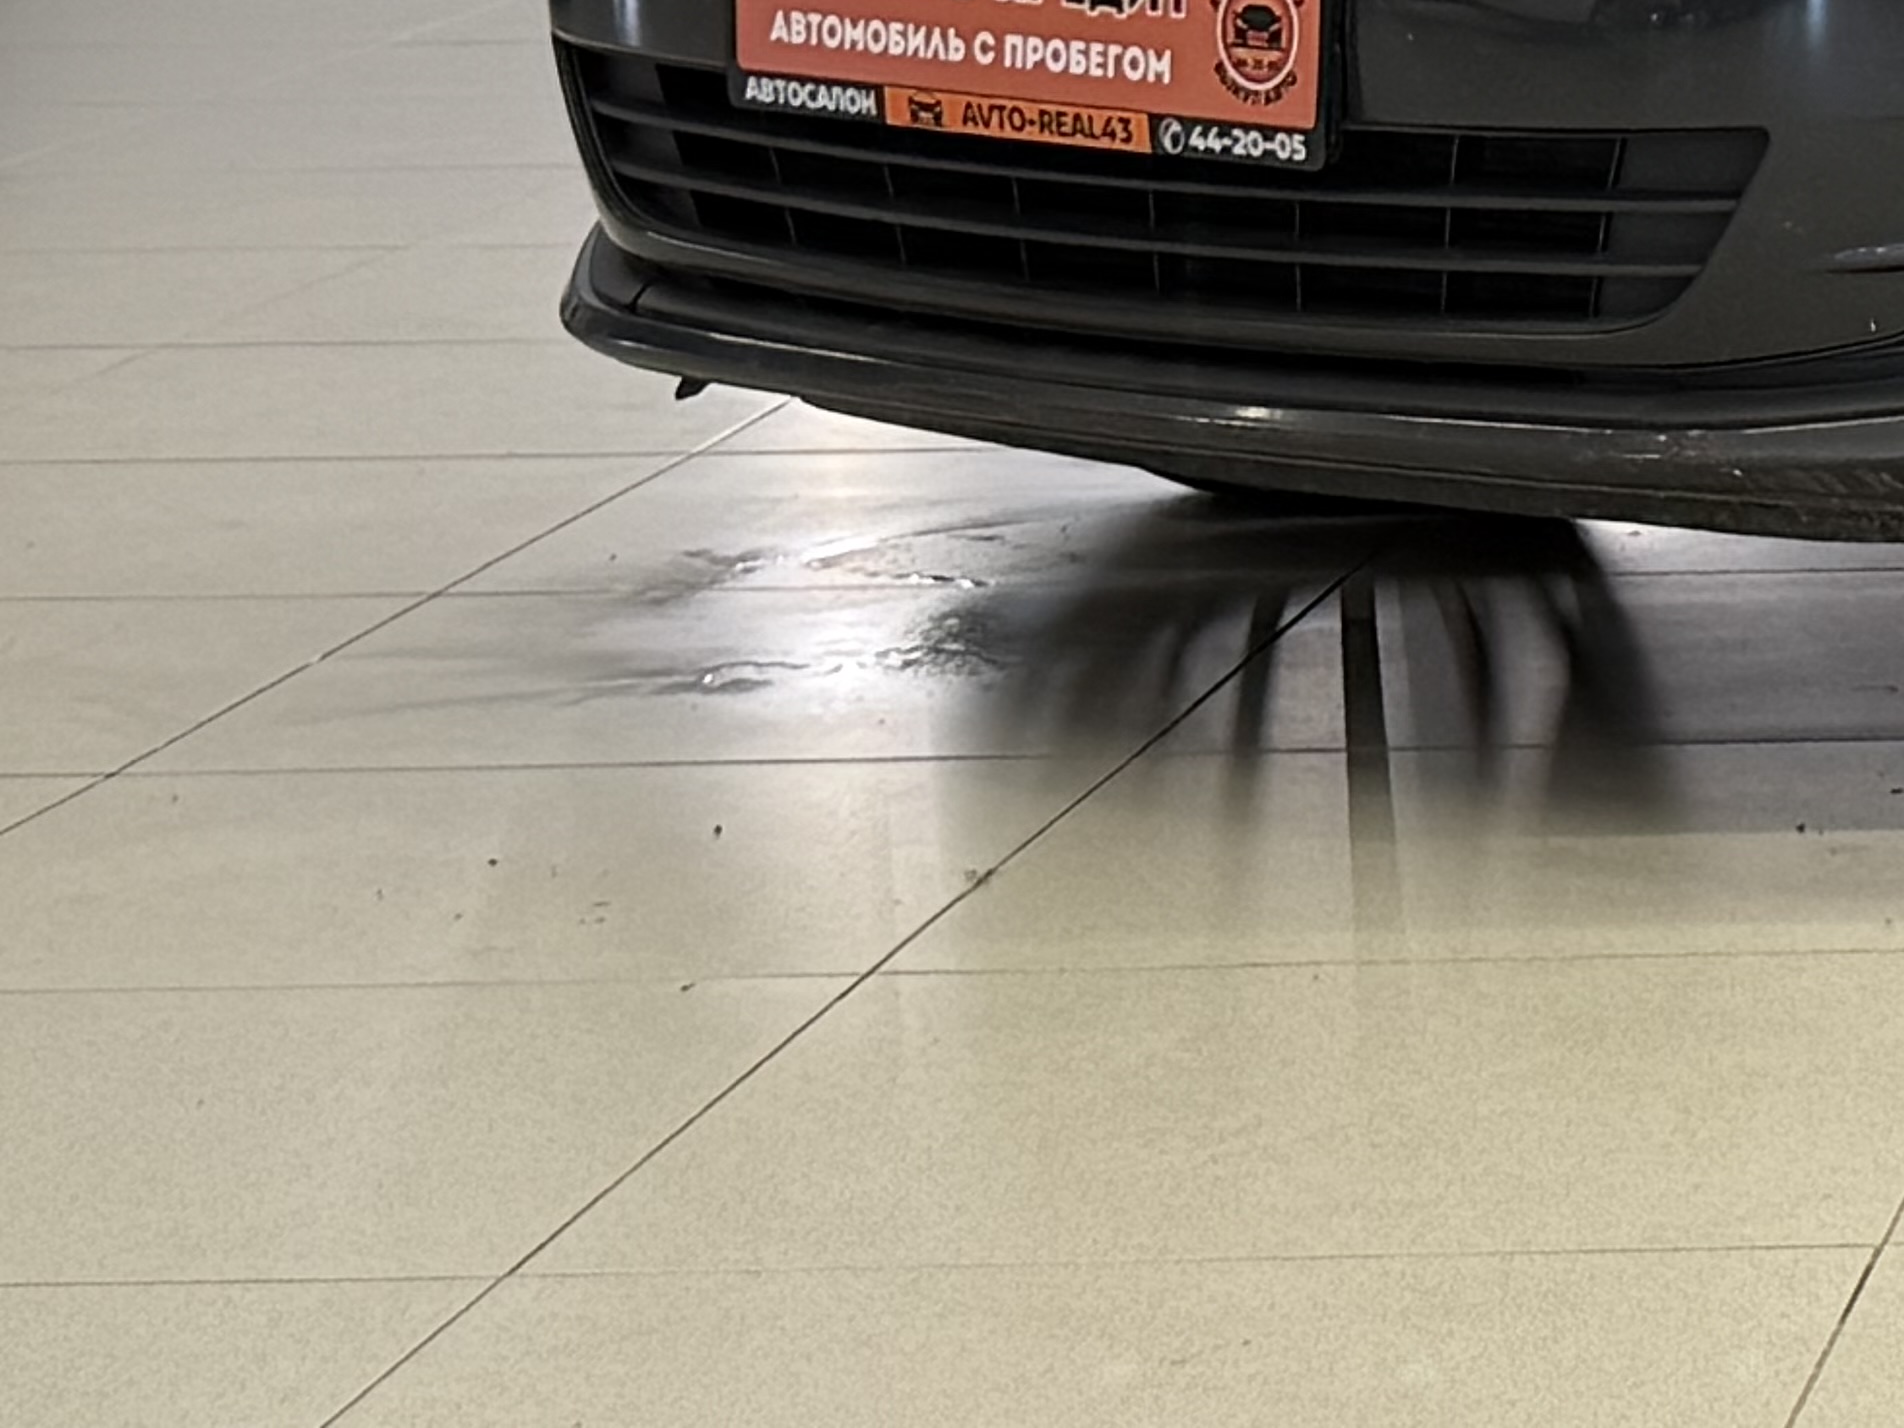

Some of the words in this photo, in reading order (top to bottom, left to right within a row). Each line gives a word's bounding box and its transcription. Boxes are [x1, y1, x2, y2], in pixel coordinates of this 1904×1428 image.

[769, 9, 966, 62] АВТОМОБИЛЬ
[973, 30, 996, 65] С
[1003, 33, 1173, 84] ПРОБЕГОМ
[745, 75, 878, 117] АВТОСАЛОН
[961, 100, 1135, 144] AVTO-REAL43
[1188, 126, 1307, 162] 44-20-05
